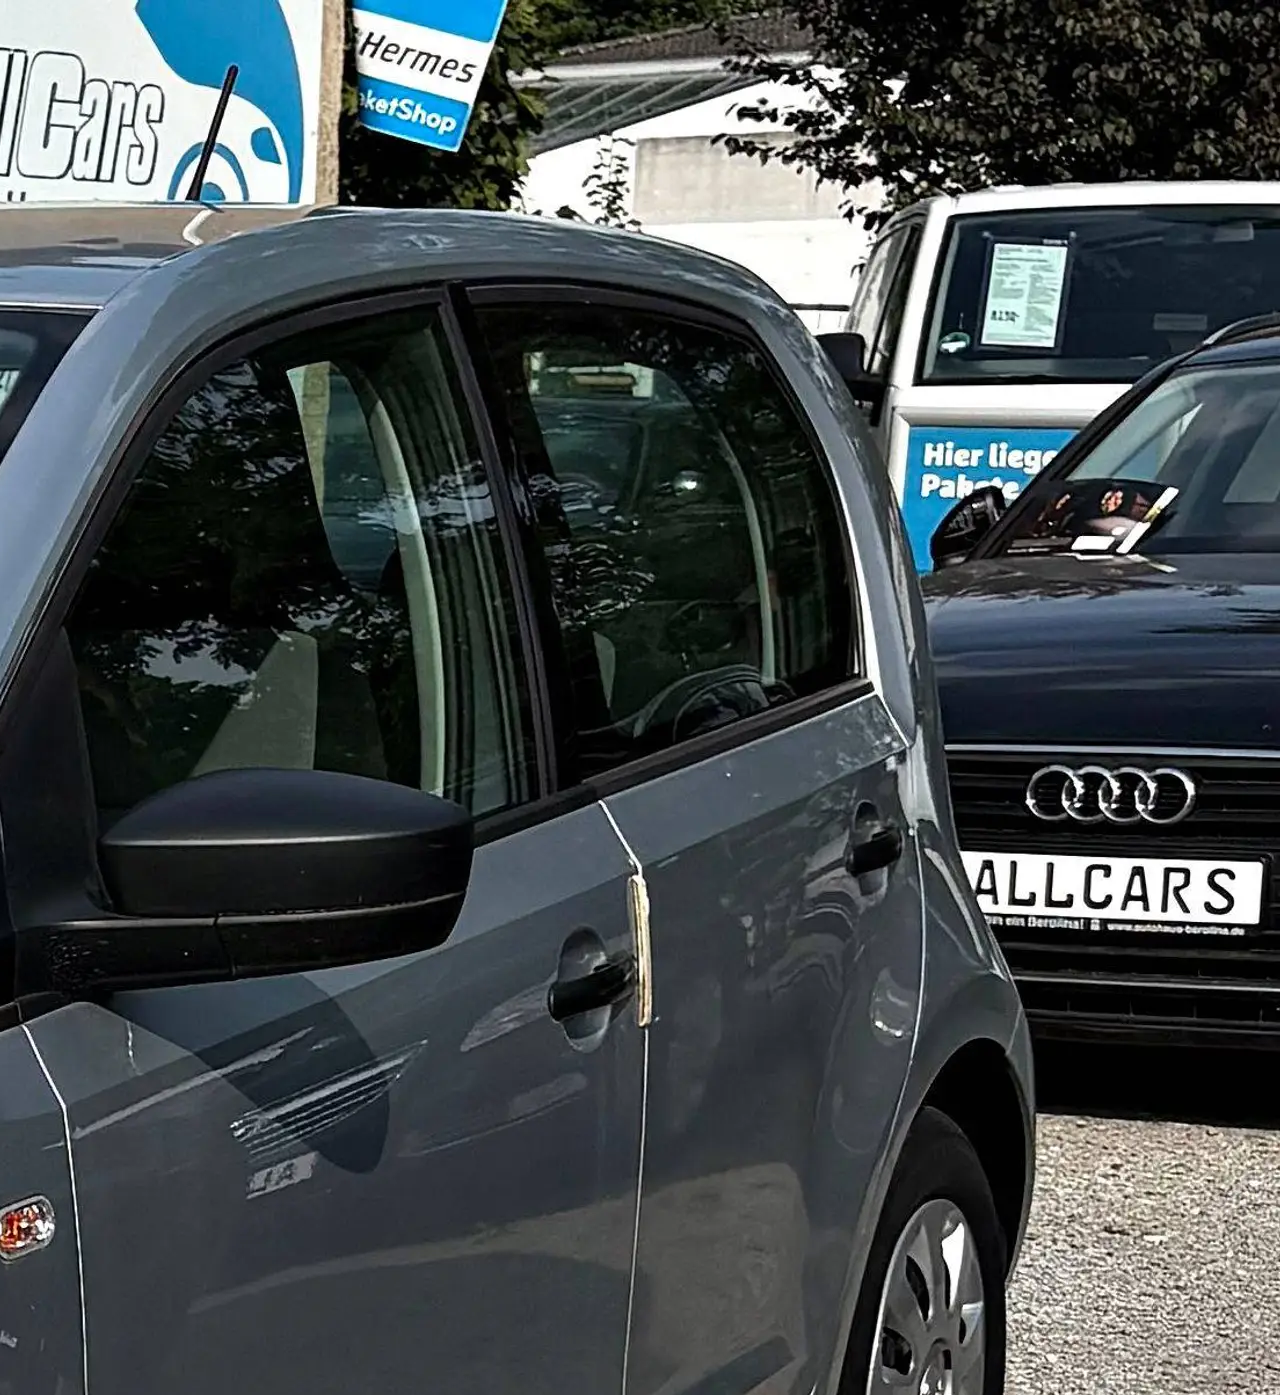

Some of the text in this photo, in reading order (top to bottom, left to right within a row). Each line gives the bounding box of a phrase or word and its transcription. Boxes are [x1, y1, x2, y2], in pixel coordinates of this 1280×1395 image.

[359, 31, 477, 83] Hermes
[923, 441, 984, 467] Hier
[975, 859, 1237, 915] ALLCARS
